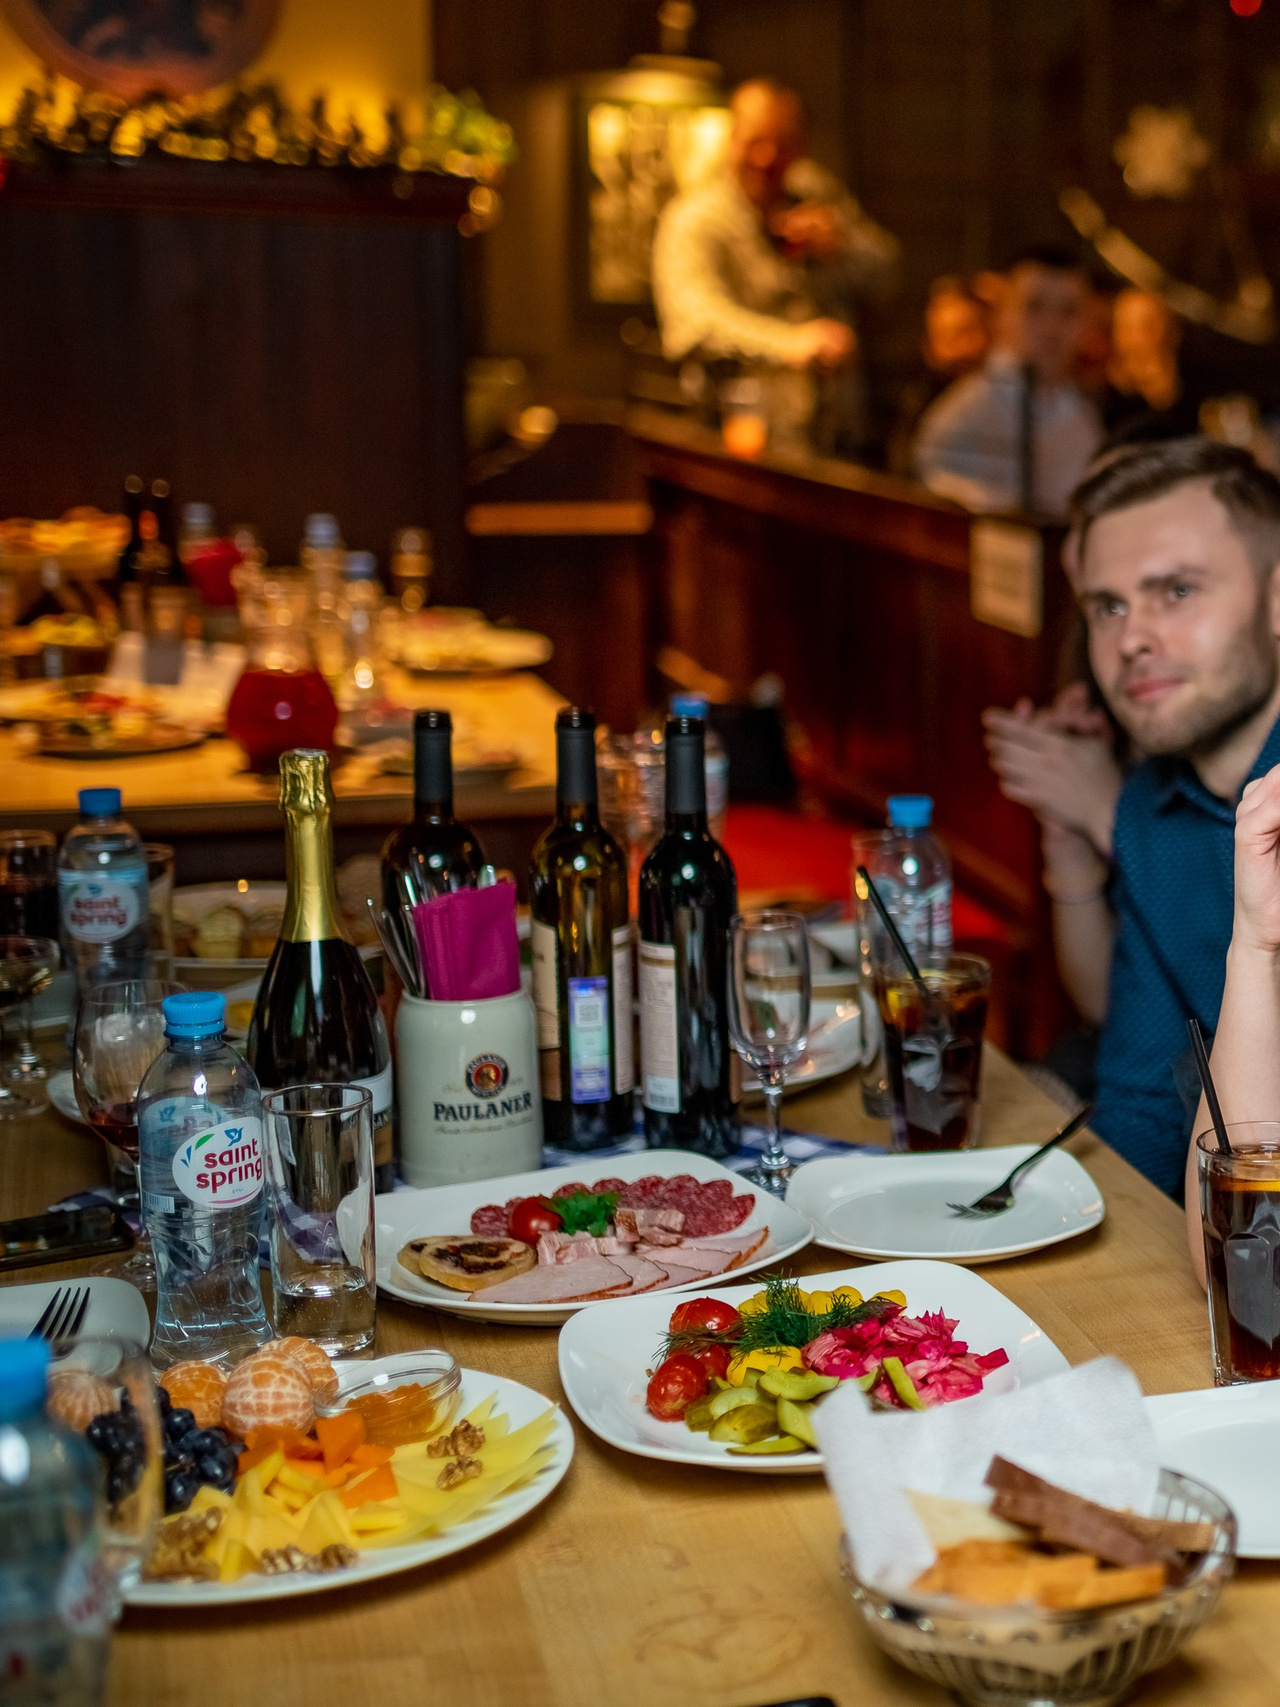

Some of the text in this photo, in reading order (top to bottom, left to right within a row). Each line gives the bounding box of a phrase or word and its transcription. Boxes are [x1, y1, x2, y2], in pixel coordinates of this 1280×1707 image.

[432, 1090, 533, 1121] PAULANER
[203, 1137, 259, 1169] saint
[195, 1156, 263, 1194] spring
